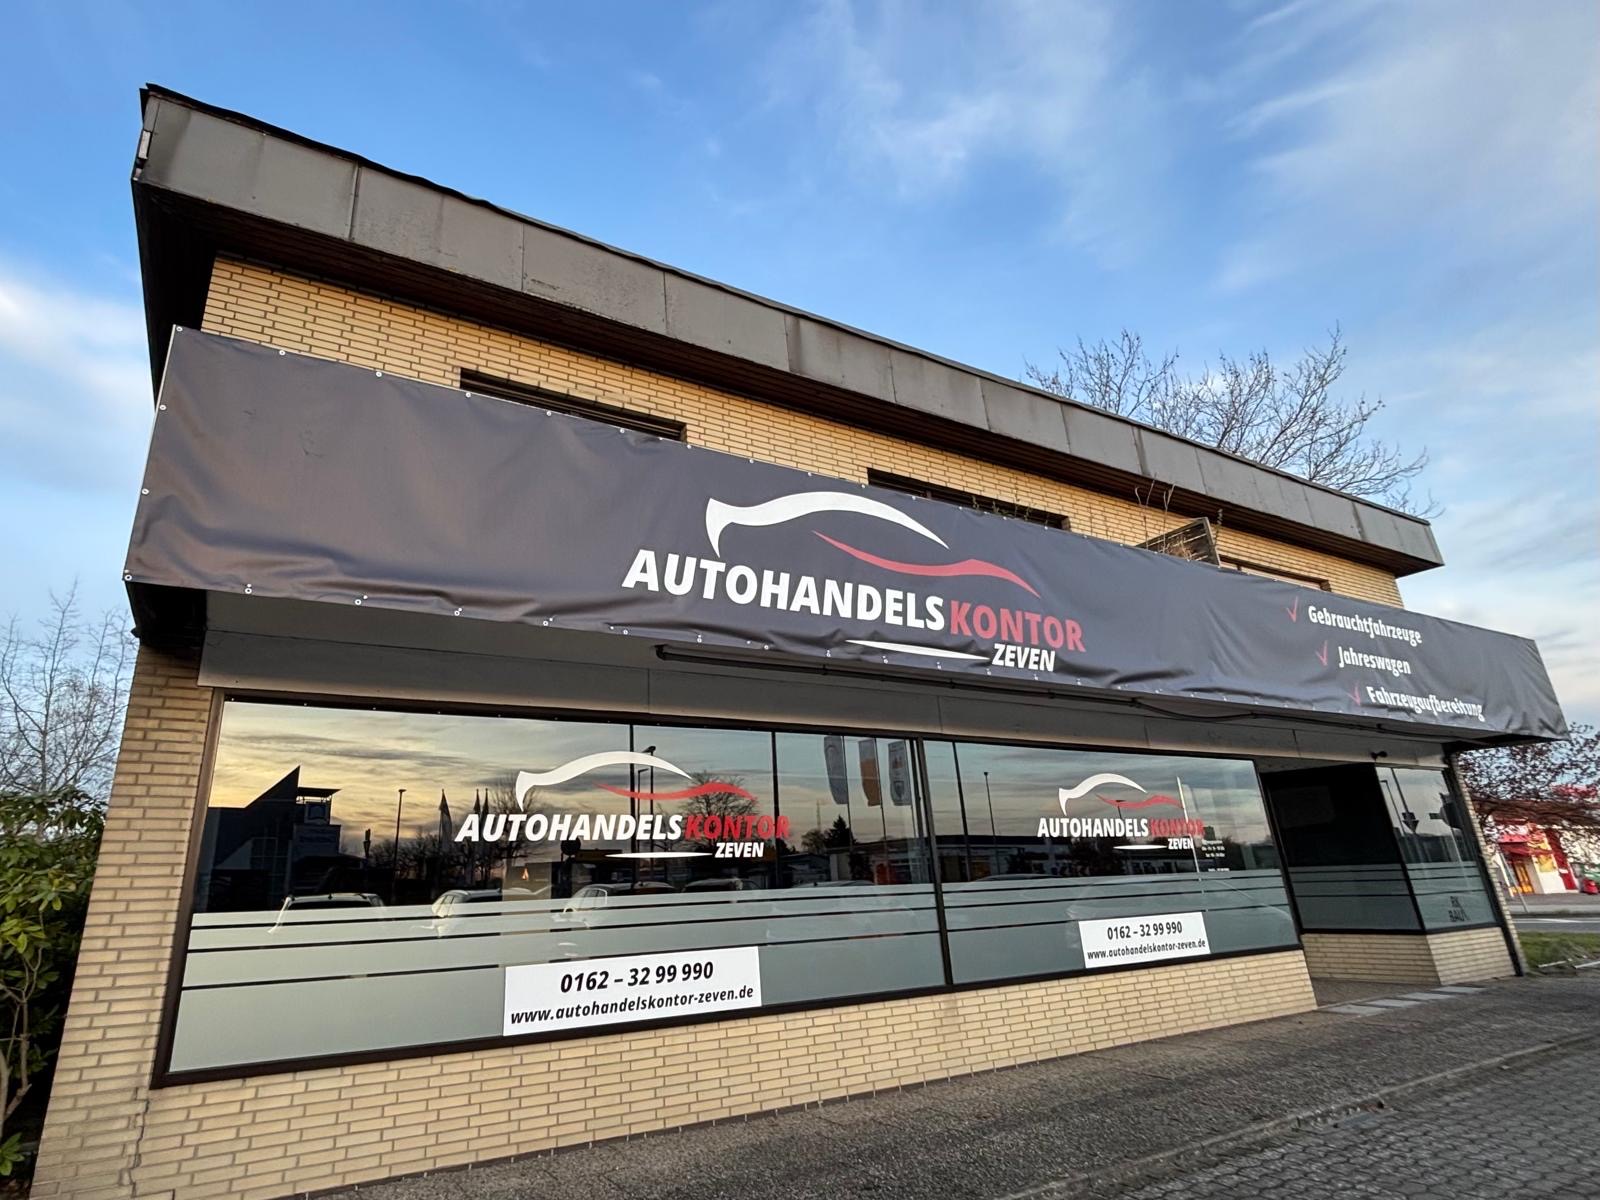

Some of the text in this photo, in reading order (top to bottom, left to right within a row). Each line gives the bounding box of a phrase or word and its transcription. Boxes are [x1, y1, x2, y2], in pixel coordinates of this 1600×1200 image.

[622, 548, 1086, 653] AUTOHANDELS KONTOR
[1308, 605, 1422, 647] Gebrauchtfahrzeuge
[992, 642, 1055, 672] ZEVEN
[1338, 646, 1411, 677] Jahreswagen
[1366, 686, 1485, 722] Fahrzeugaufbereitung
[455, 813, 792, 842] AUTOHANDELS KONTOR
[1037, 817, 1205, 838] AUTOHANDELS KONTOR
[714, 842, 764, 859] ZEVEN
[1168, 838, 1193, 850] ZEVEN
[1107, 925, 1131, 940] 0162
[1139, 924, 1151, 938] 32
[1153, 923, 1164, 936] 99
[1166, 921, 1183, 934] 990
[1087, 938, 1206, 960] www.autohandelskontor-zeven.de
[560, 970, 609, 993] 0162
[628, 966, 651, 987] 32
[655, 964, 678, 984] 99
[681, 961, 714, 981] 990
[510, 985, 754, 1025] www.autohandelskontor-zeven.de
